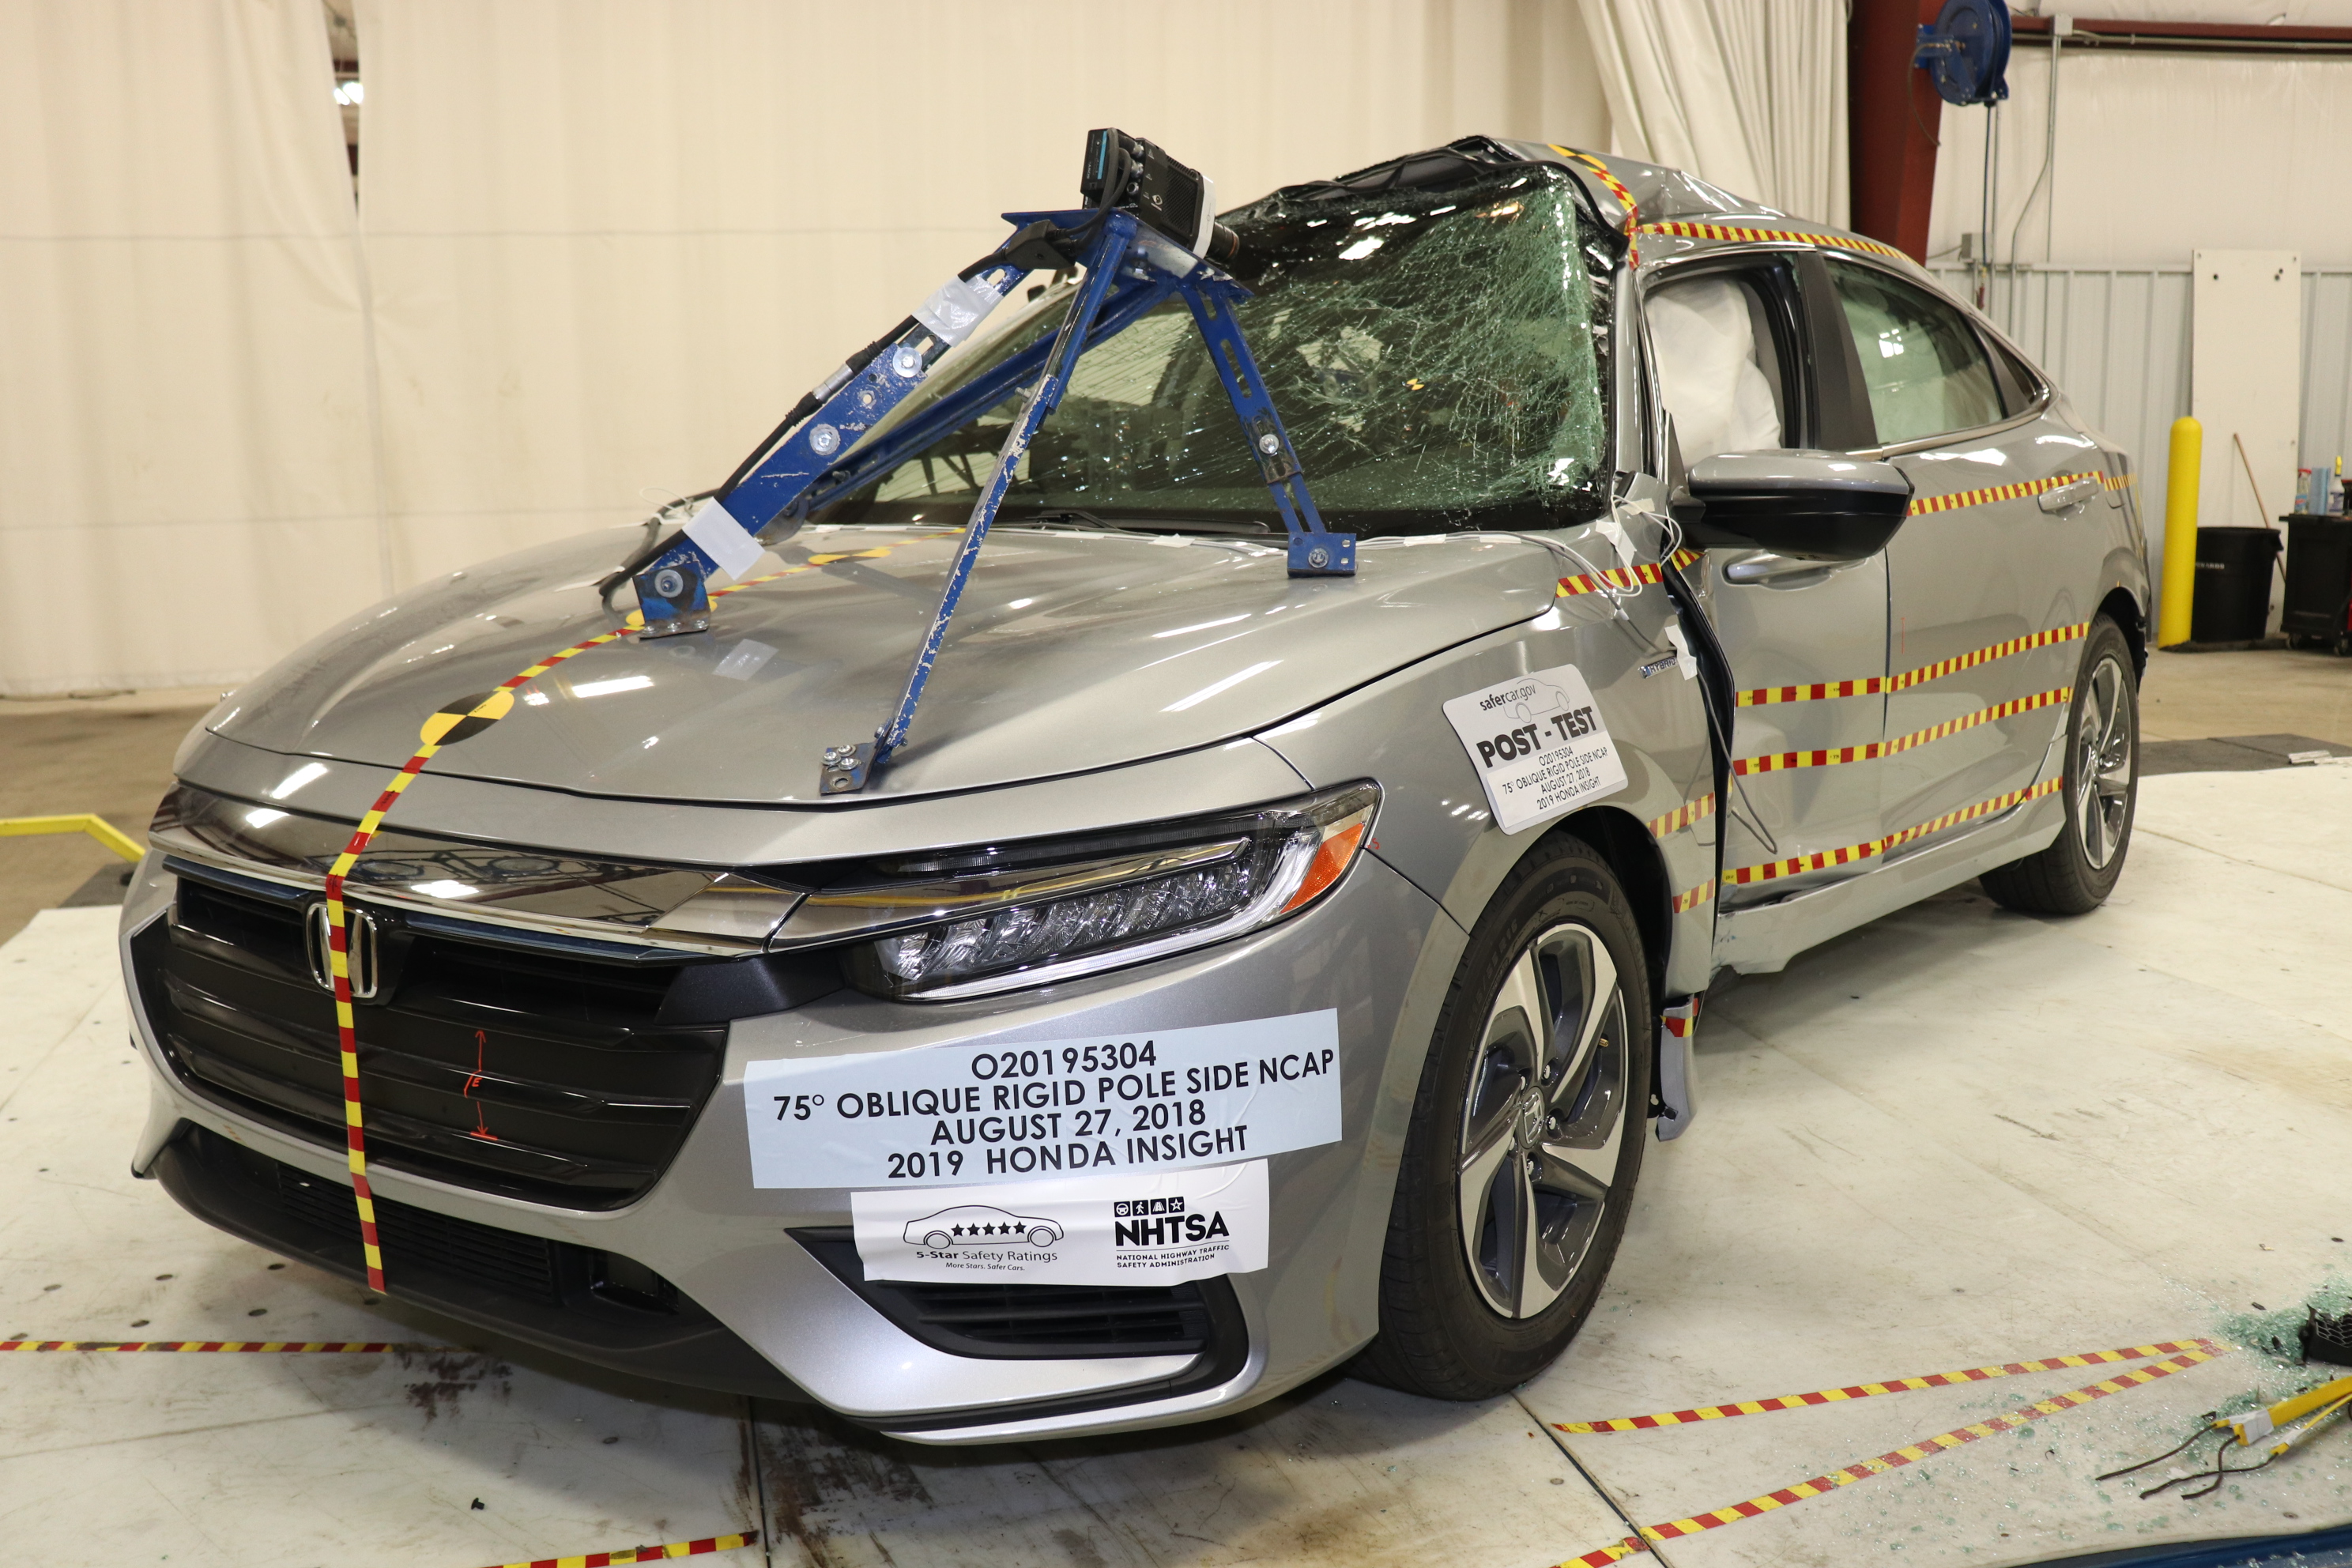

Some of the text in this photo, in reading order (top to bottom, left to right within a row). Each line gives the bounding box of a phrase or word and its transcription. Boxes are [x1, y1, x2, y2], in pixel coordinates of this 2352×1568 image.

[1649, 657, 1676, 673] HYBRID
[1479, 684, 1536, 711] safercar.gov
[1476, 723, 1541, 768] POST
[1551, 706, 1597, 741] TEST
[1516, 769, 1547, 790] OBLIQUE
[1546, 763, 1566, 778] RIGID
[1565, 756, 1581, 771] POLE
[1579, 752, 1593, 765] SIDE
[1592, 746, 1608, 760] NCAP
[1540, 775, 1567, 795] AUGUST
[1576, 767, 1591, 780] 2018
[1536, 775, 1601, 810] 2019 HONDA INSIGHT
[774, 1049, 1334, 1121] 75° OBLIQUE RIGID POLE SIDE NCAP
[930, 1099, 1206, 1145] AUGUST 27, 2018
[888, 1125, 1248, 1178] 2019 HONDA INSIGHT
[1114, 1211, 1230, 1246] NHTSA
[916, 1250, 1058, 1263] 5-Star Safety Ratings
[1149, 1253, 1216, 1268] ADMINISTRATION
[1160, 1250, 1197, 1260] HIGHWAY
[1200, 1244, 1230, 1254] TRAFFIC
